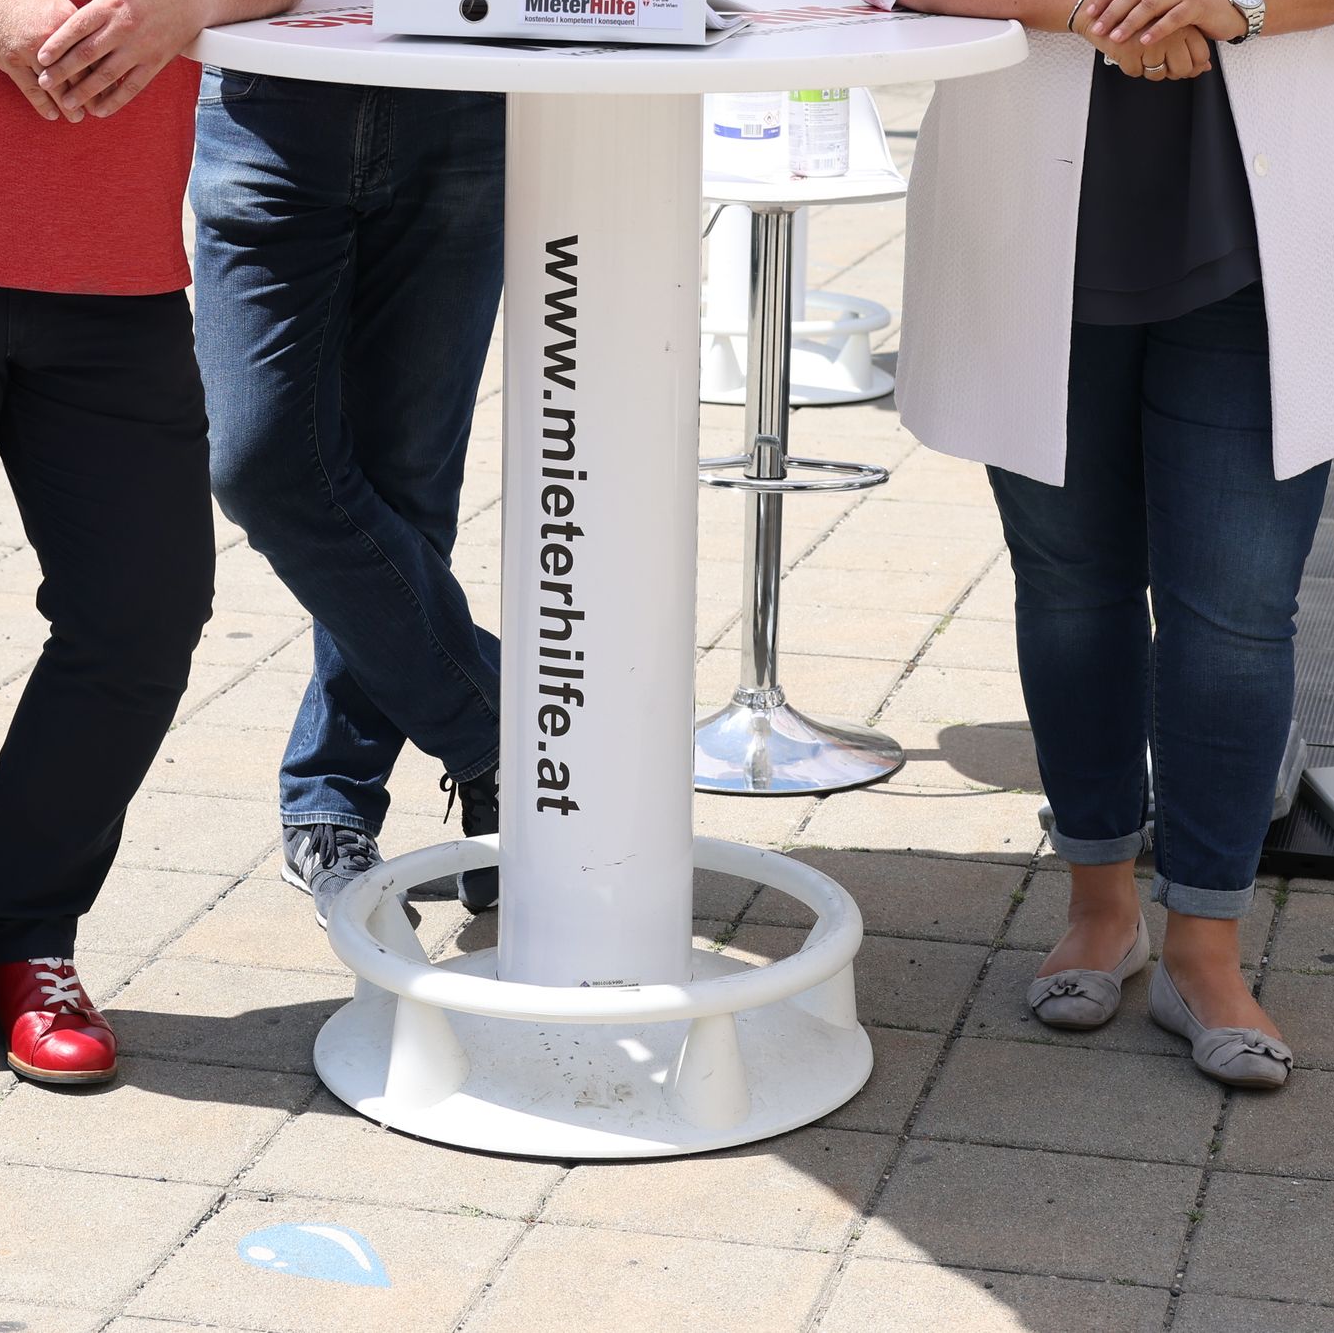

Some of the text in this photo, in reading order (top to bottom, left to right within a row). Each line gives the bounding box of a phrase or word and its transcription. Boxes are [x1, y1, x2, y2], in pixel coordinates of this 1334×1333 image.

[524, 15, 555, 24] kostenlos
[560, 16, 594, 25] kompetent
[598, 17, 635, 27] konsequent
[536, 234, 588, 817] www.mieterhilfe.at
